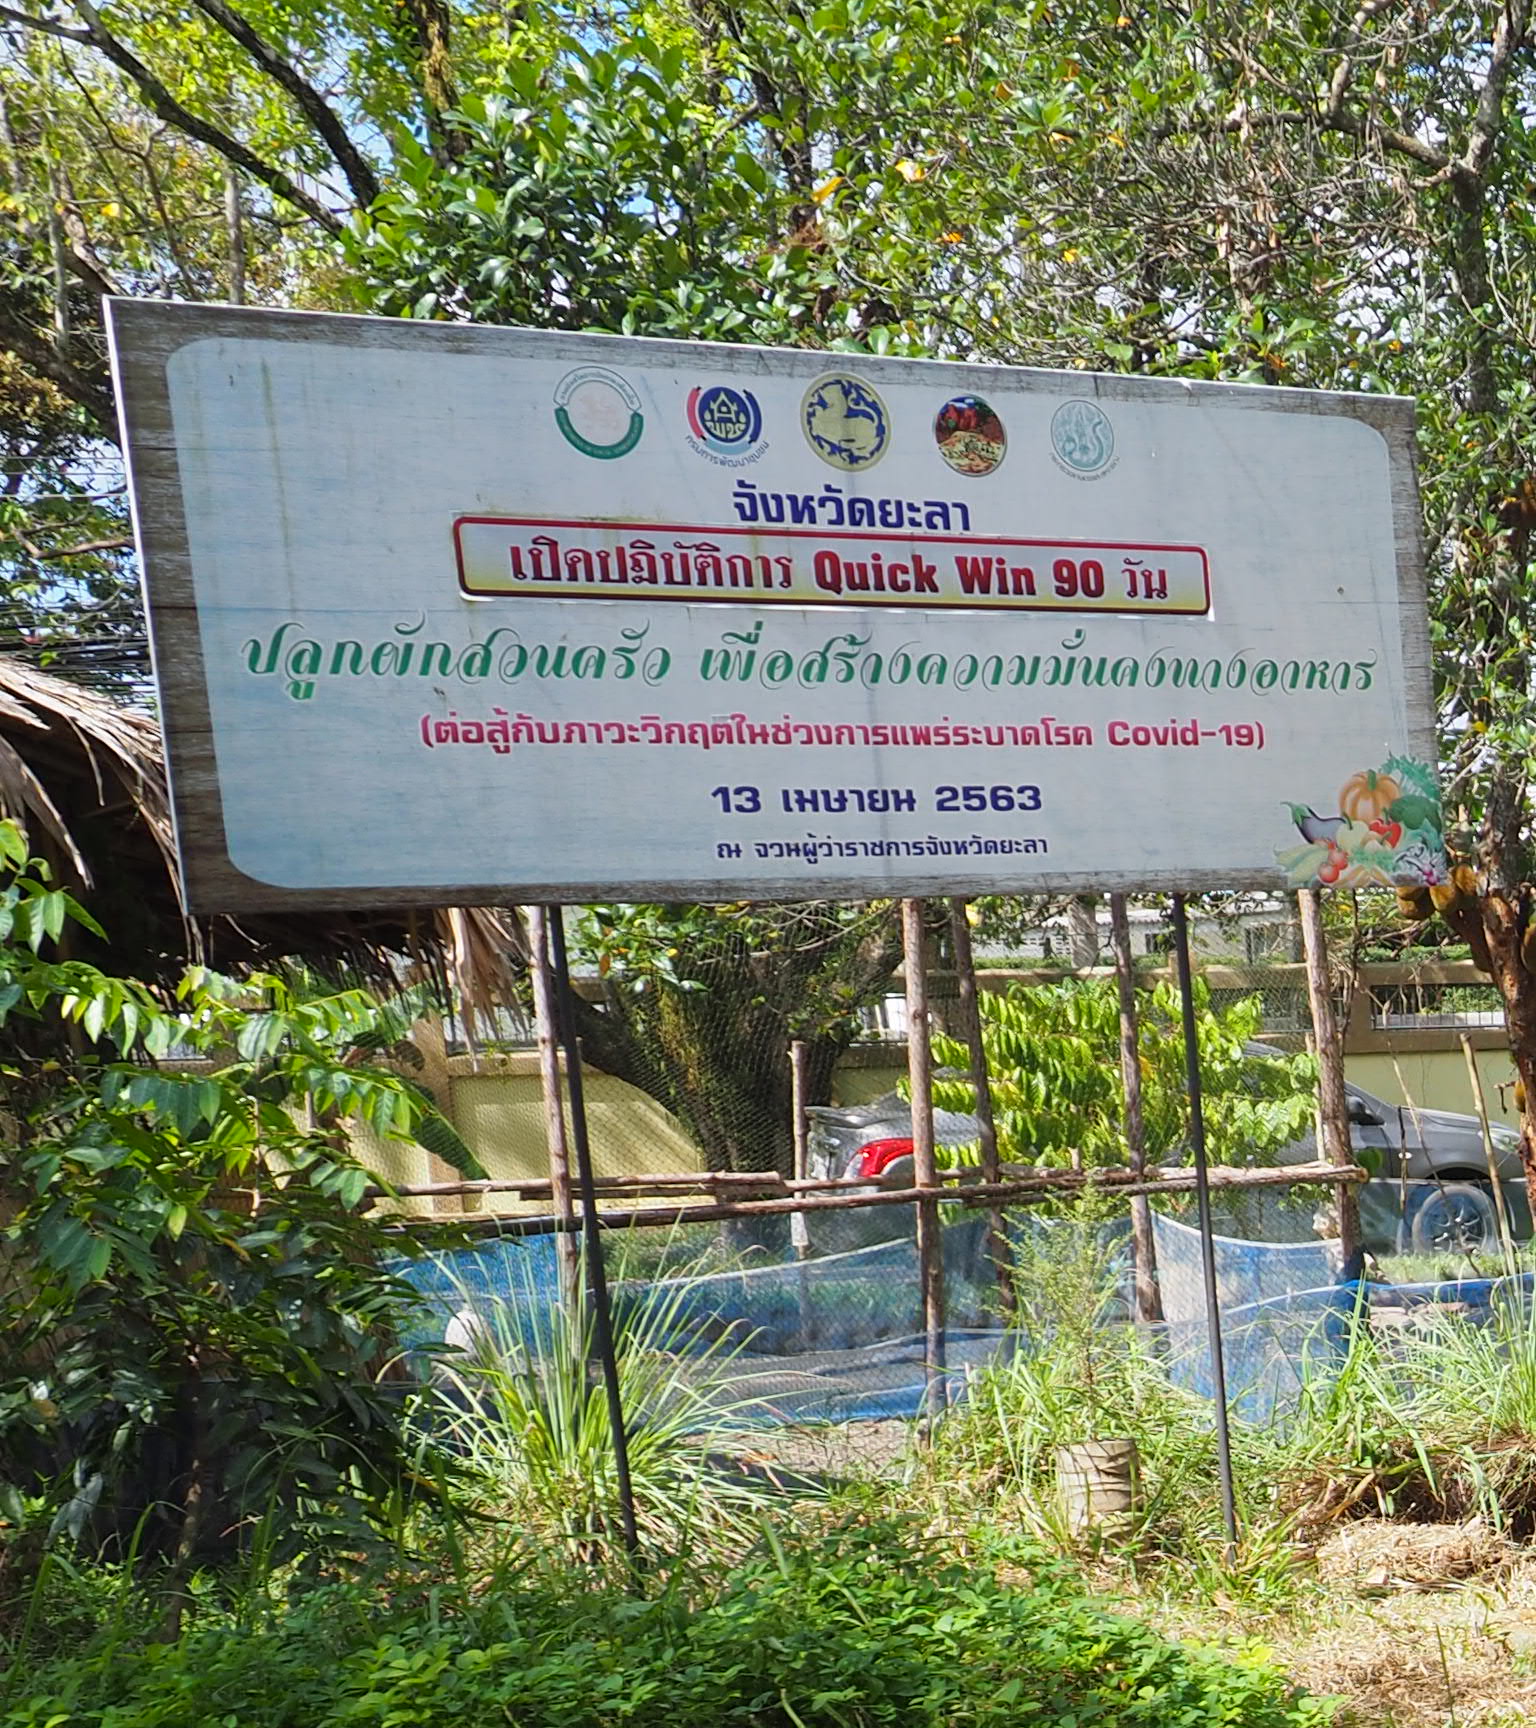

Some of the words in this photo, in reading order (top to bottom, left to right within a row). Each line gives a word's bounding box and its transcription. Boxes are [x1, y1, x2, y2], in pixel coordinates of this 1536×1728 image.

[732, 479, 971, 532] จังหวัดยะลา
[813, 549, 940, 597] Quick
[955, 555, 1037, 596] Win
[1052, 558, 1105, 598] 90
[1120, 557, 1169, 600] วัน
[239, 611, 673, 700] ปลูกผักสวนครัว
[699, 620, 1378, 692] เพื่อสร้างความมั่นคงทางอาหาร
[1107, 718, 1265, 750] Covid-19)
[711, 785, 762, 813] 13
[781, 788, 917, 813] เมษายน
[934, 785, 1043, 812] 2563
[716, 841, 742, 859] ณ
[754, 832, 1049, 865] จวนผู้ว่าราชการจังหวัดยะลา
